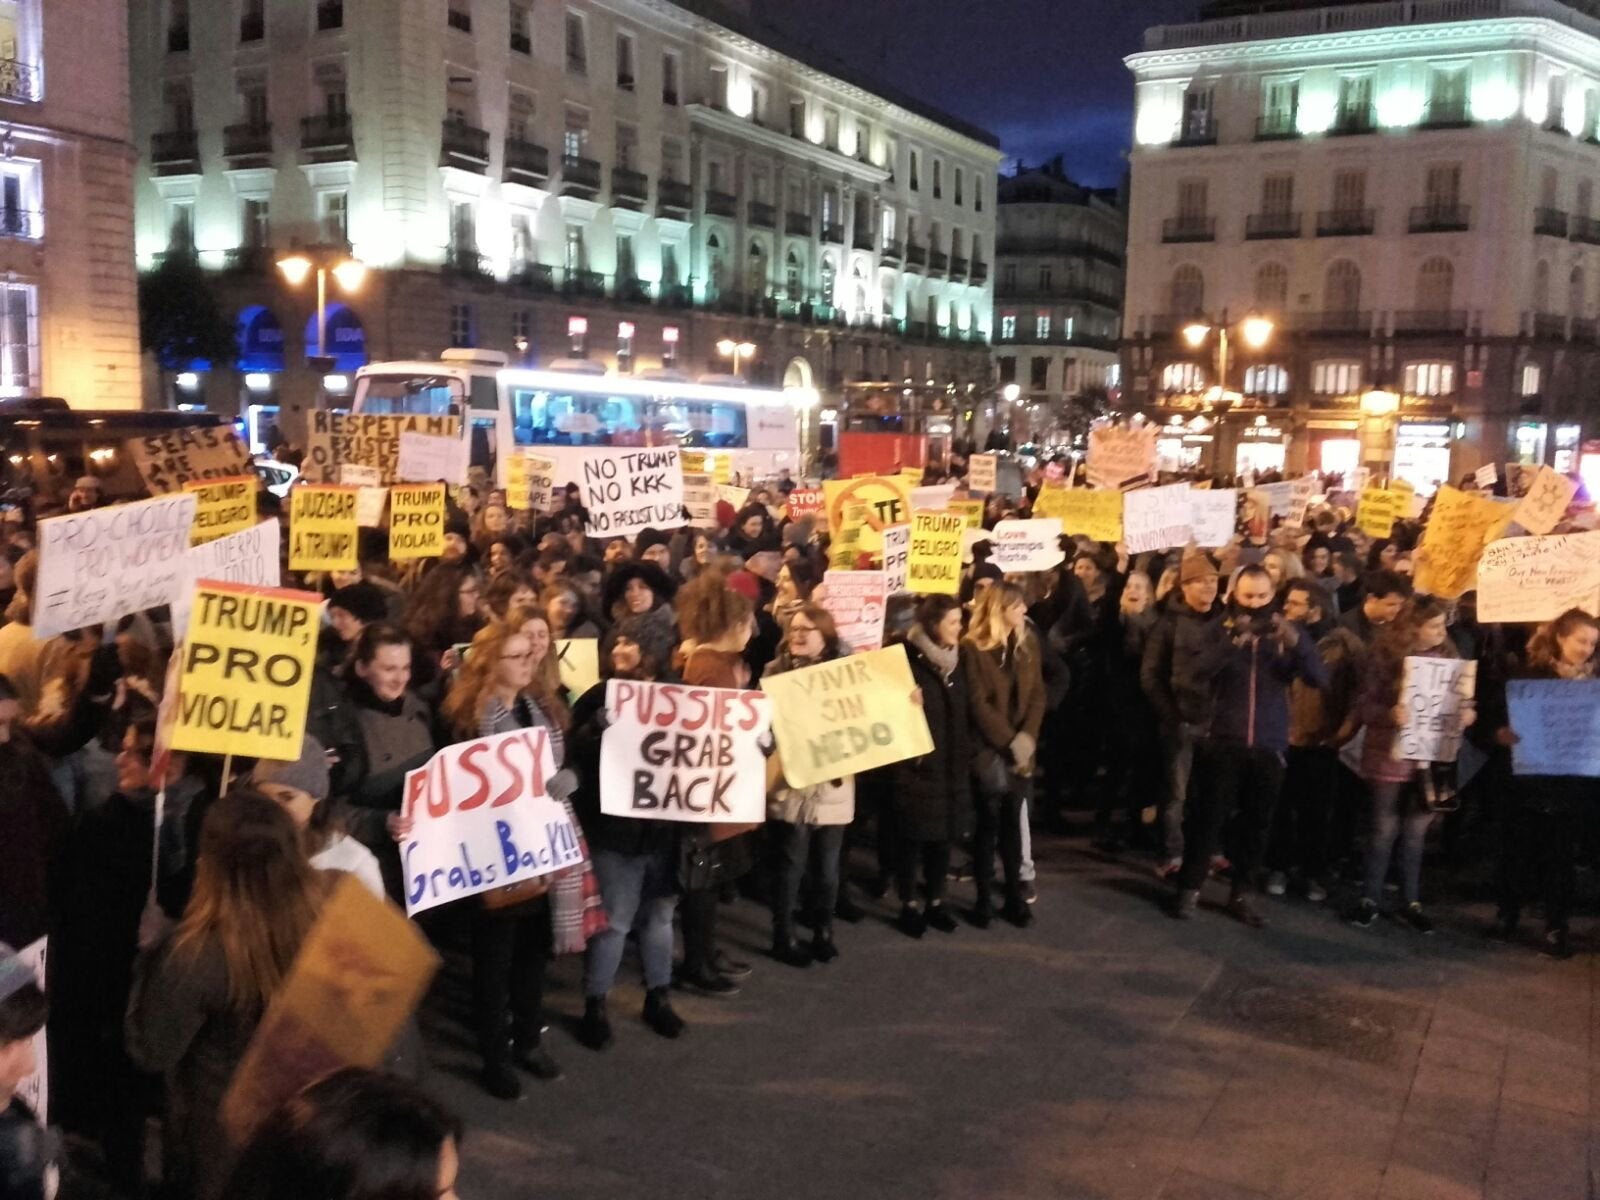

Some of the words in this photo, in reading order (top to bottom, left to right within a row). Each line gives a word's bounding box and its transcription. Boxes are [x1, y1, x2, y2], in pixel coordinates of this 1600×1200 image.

[314, 411, 417, 436] RESPETA
[427, 415, 453, 436] MI
[330, 435, 399, 455] EXISTE
[584, 458, 616, 485] NO
[620, 450, 677, 474] TRUMP
[394, 490, 442, 507] TRUMP,
[588, 481, 622, 508] NO
[630, 473, 673, 498] KKK
[392, 511, 441, 527] PRO
[587, 511, 610, 533] NO
[916, 515, 962, 537] TRUMP,
[391, 533, 438, 550] VIOLAR.
[911, 538, 959, 557] PELIGRO
[886, 551, 908, 571] PR
[197, 592, 310, 646] TRUMP,
[184, 642, 303, 688] PRO
[792, 659, 873, 696] VIVIR
[179, 692, 294, 739] VIOLAR.
[614, 682, 767, 732] PUSSIES
[820, 693, 867, 723] SIN
[640, 730, 735, 768] GRAB
[406, 729, 547, 819] PUSSY
[631, 769, 737, 815] BACK
[406, 840, 496, 905] Grabs
